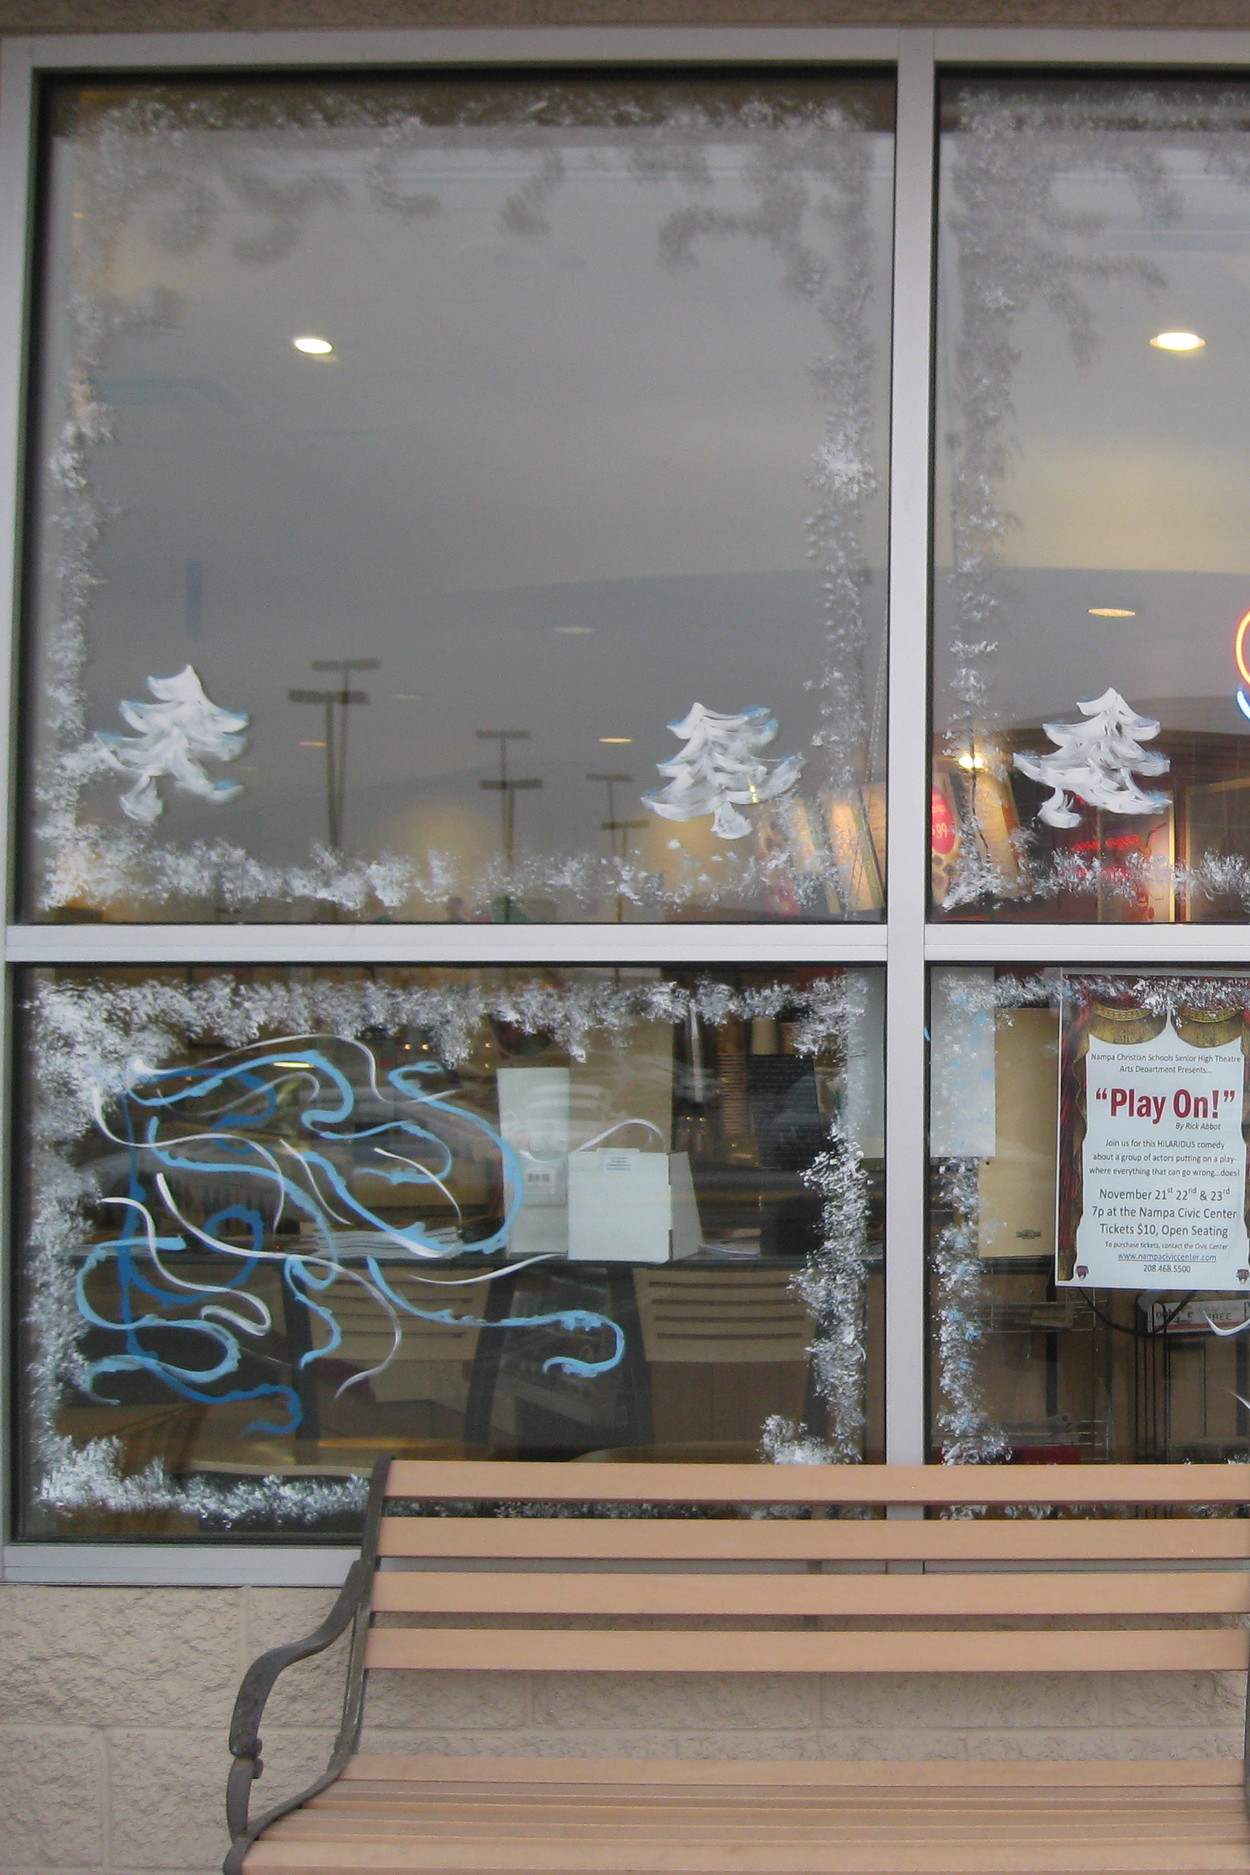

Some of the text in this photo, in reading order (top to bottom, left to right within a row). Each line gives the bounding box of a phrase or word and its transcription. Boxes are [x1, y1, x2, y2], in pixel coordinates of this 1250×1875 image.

[1091, 1053, 1241, 1063] Nampa Christian Schools Senior High Theatre
[1119, 1065, 1134, 1073] Arts
[1135, 1065, 1176, 1074] Department
[1175, 1122, 1222, 1131] By Rick Abbot
[1105, 1139, 1120, 1147] Join
[1131, 1139, 1141, 1147] for
[1142, 1139, 1156, 1148] this
[1157, 1140, 1196, 1148] HILARIOUS
[1197, 1141, 1225, 1150] comedy
[1093, 1153, 1113, 1161] about
[1121, 1154, 1142, 1162] group
[1143, 1153, 1151, 1161] of
[1152, 1154, 1174, 1162] actors
[1175, 1154, 1201, 1163] putting
[1089, 1167, 1111, 1175] where
[1113, 1167, 1150, 1177] everything
[1151, 1167, 1167, 1175] that
[1182, 1169, 1191, 1177] go
[1099, 1188, 1152, 1199] November
[1199, 1190, 1208, 1201] &
[1092, 1206, 1236, 1219] 7p at the Nampa Civic Center
[1100, 1223, 1228, 1238] Tickets $10, Open Seating
[1143, 1264, 1191, 1273] 208.468.5500
